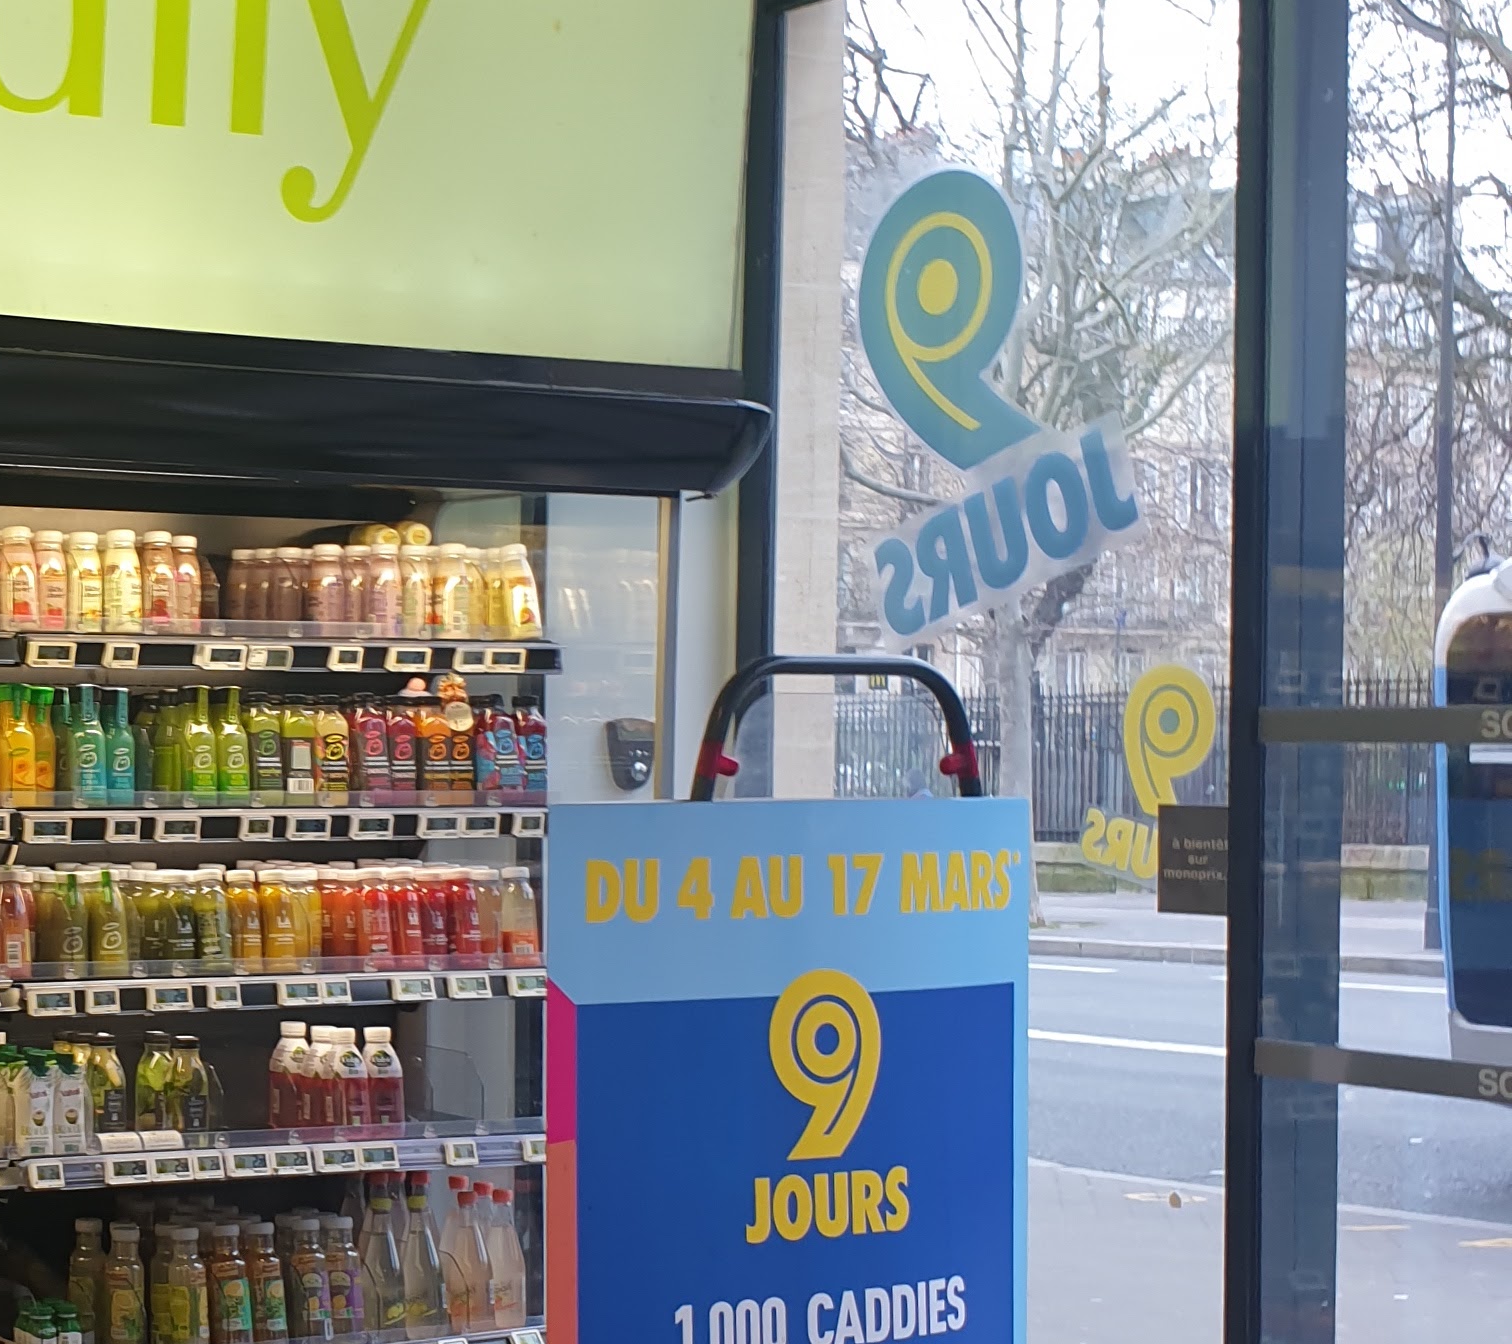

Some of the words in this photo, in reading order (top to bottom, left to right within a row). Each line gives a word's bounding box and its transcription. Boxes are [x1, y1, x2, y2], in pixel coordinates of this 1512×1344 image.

[584, 858, 659, 923] DU
[676, 857, 714, 919] 4
[730, 854, 803, 919] AU
[828, 851, 882, 917] 17
[768, 967, 882, 1161] 9
[744, 1166, 911, 1245] JOURS
